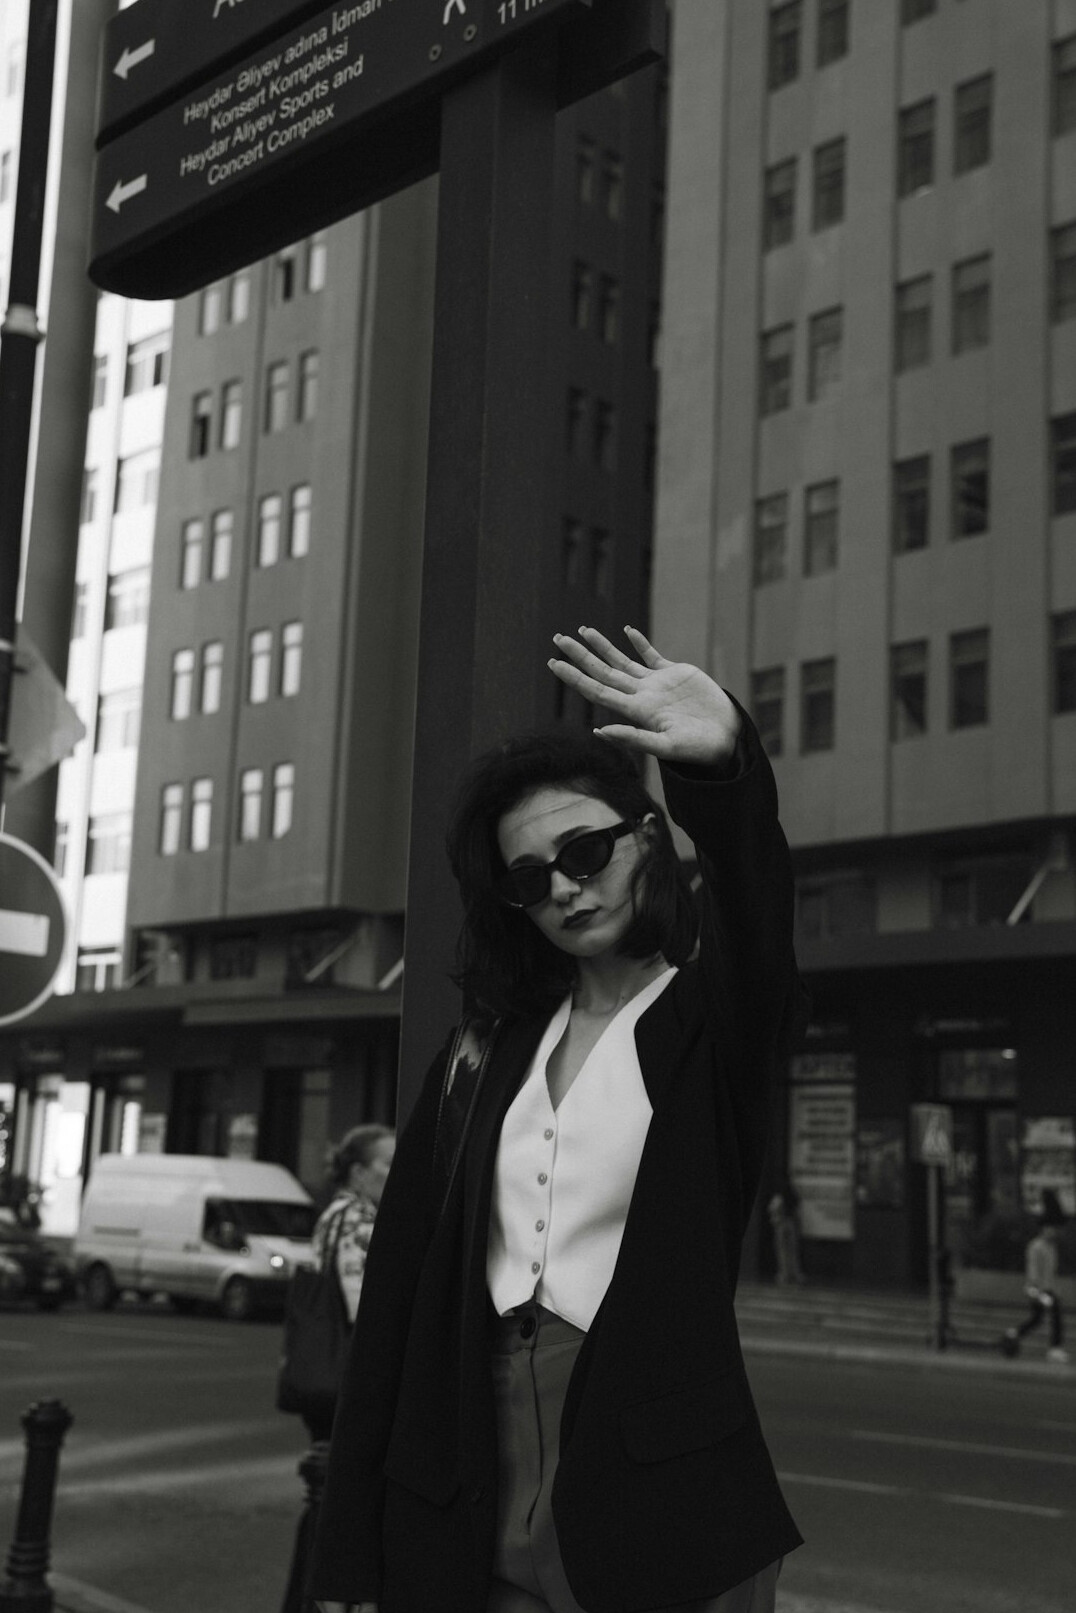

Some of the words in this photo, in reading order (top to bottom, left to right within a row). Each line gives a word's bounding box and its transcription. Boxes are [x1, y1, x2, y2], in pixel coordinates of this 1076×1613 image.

[180, 135, 231, 177] Heydar
[232, 110, 276, 147] Aliyev
[279, 79, 329, 119] Sports
[333, 54, 364, 89] and
[211, 87, 266, 134] Konsert
[269, 36, 348, 99] Kompleksi
[207, 139, 264, 185] Concert
[267, 103, 335, 152] Complex
